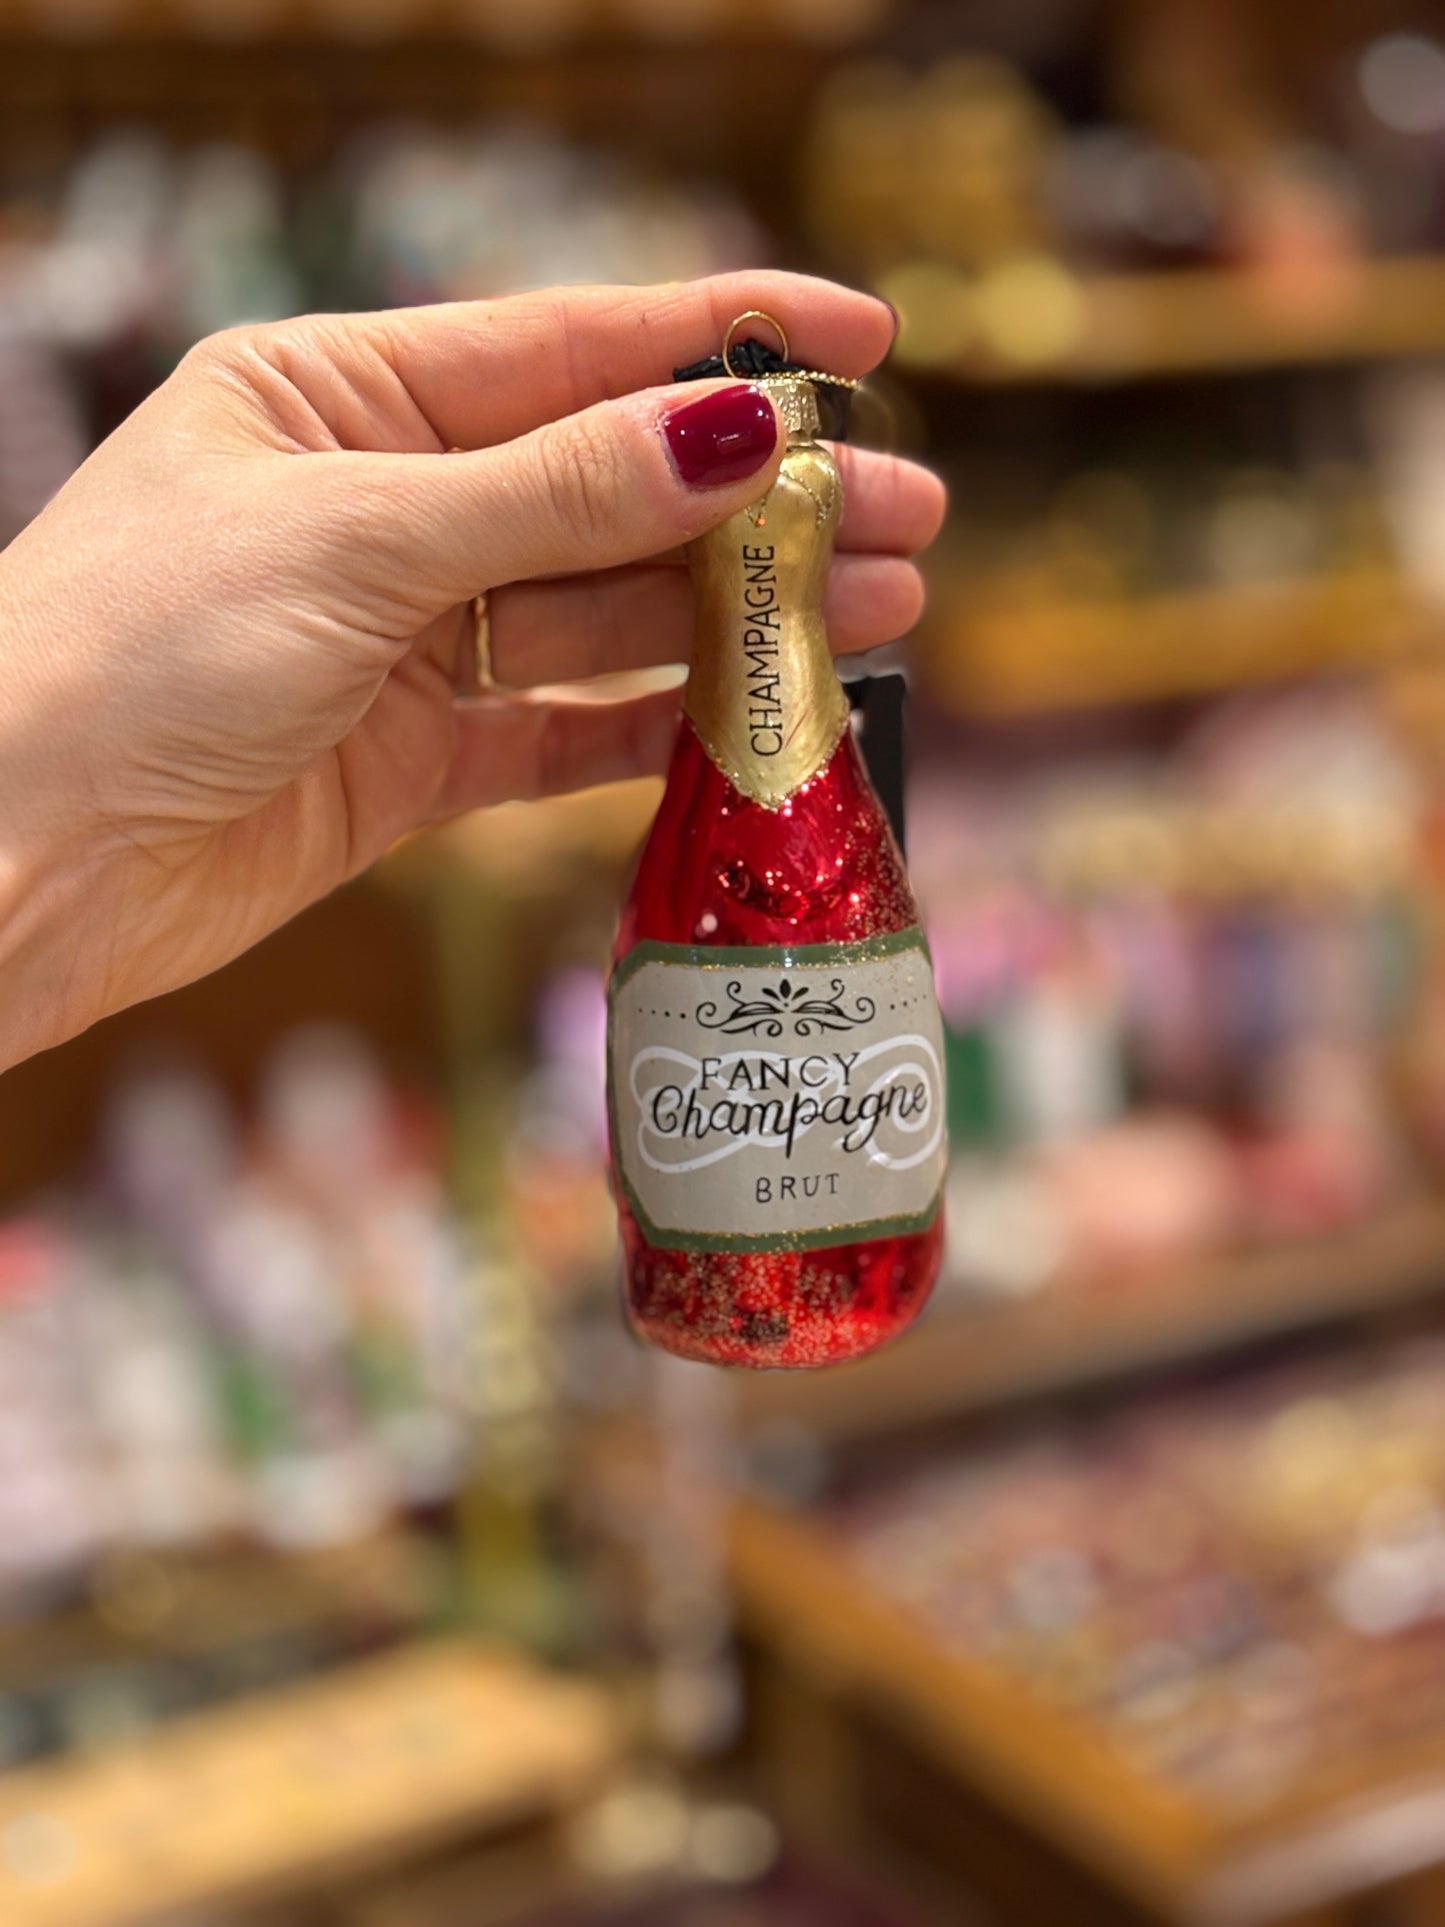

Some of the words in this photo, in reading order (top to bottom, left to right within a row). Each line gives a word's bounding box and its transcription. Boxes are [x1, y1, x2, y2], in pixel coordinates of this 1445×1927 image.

[743, 543, 785, 757] CHAMPAGNE
[700, 1052, 860, 1091] FANCY
[652, 1081, 928, 1159] Champagne
[755, 1173, 840, 1203] BRUT
